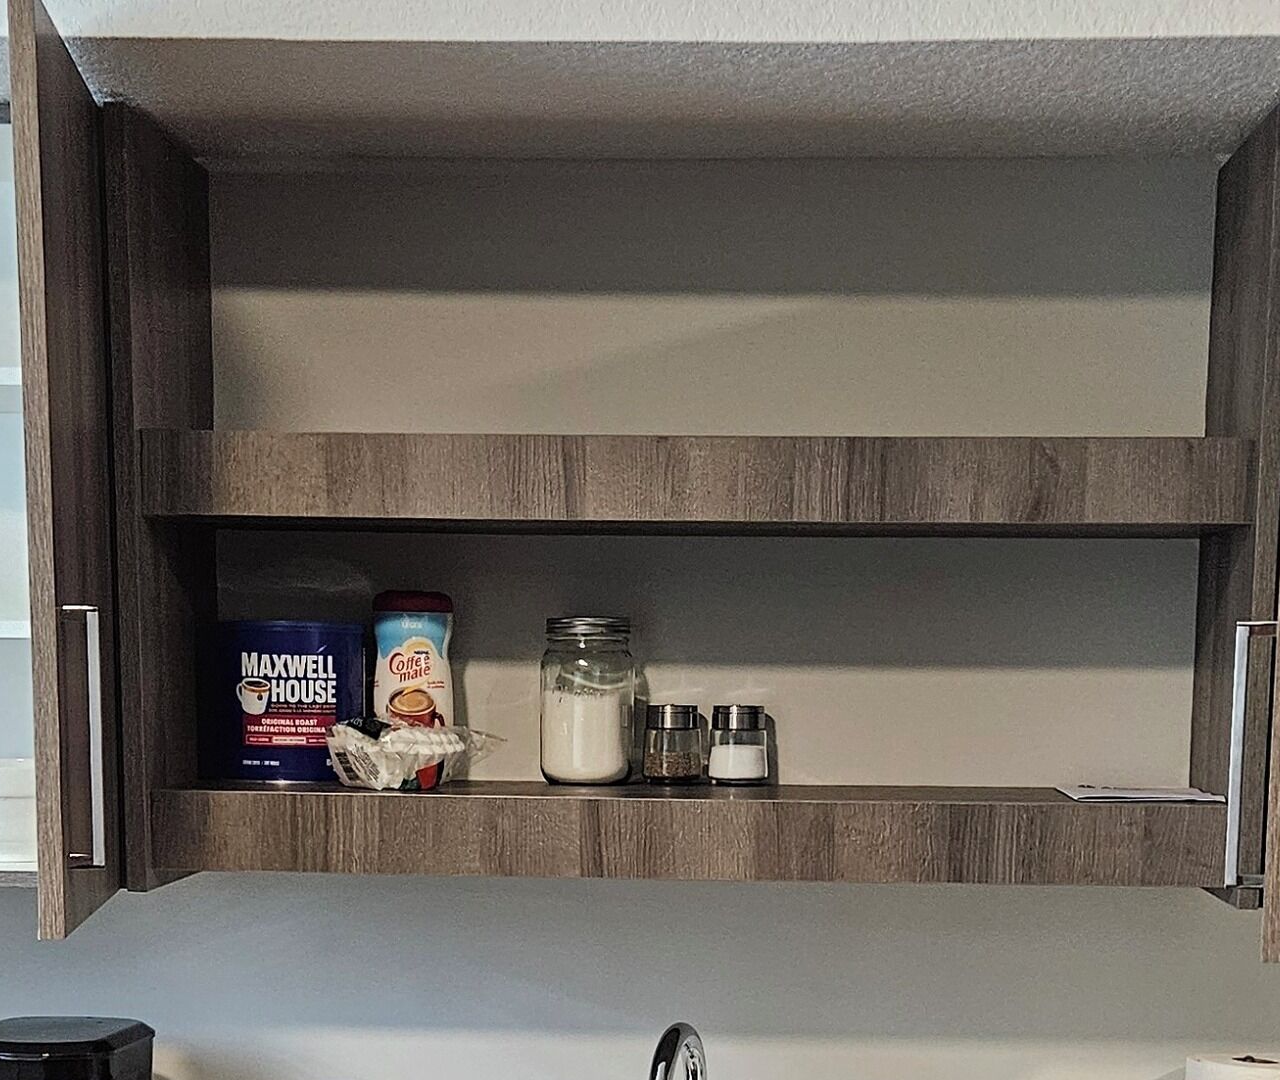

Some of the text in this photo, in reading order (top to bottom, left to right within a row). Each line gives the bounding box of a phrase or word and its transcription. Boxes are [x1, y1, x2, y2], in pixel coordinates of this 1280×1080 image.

[241, 652, 336, 679] MAXWELL
[389, 652, 430, 675] Coffee
[400, 666, 431, 683] mate
[271, 679, 336, 703] HOUSE
[247, 725, 296, 733] TORRÉFACTION
[261, 718, 294, 726] ORIGINAL
